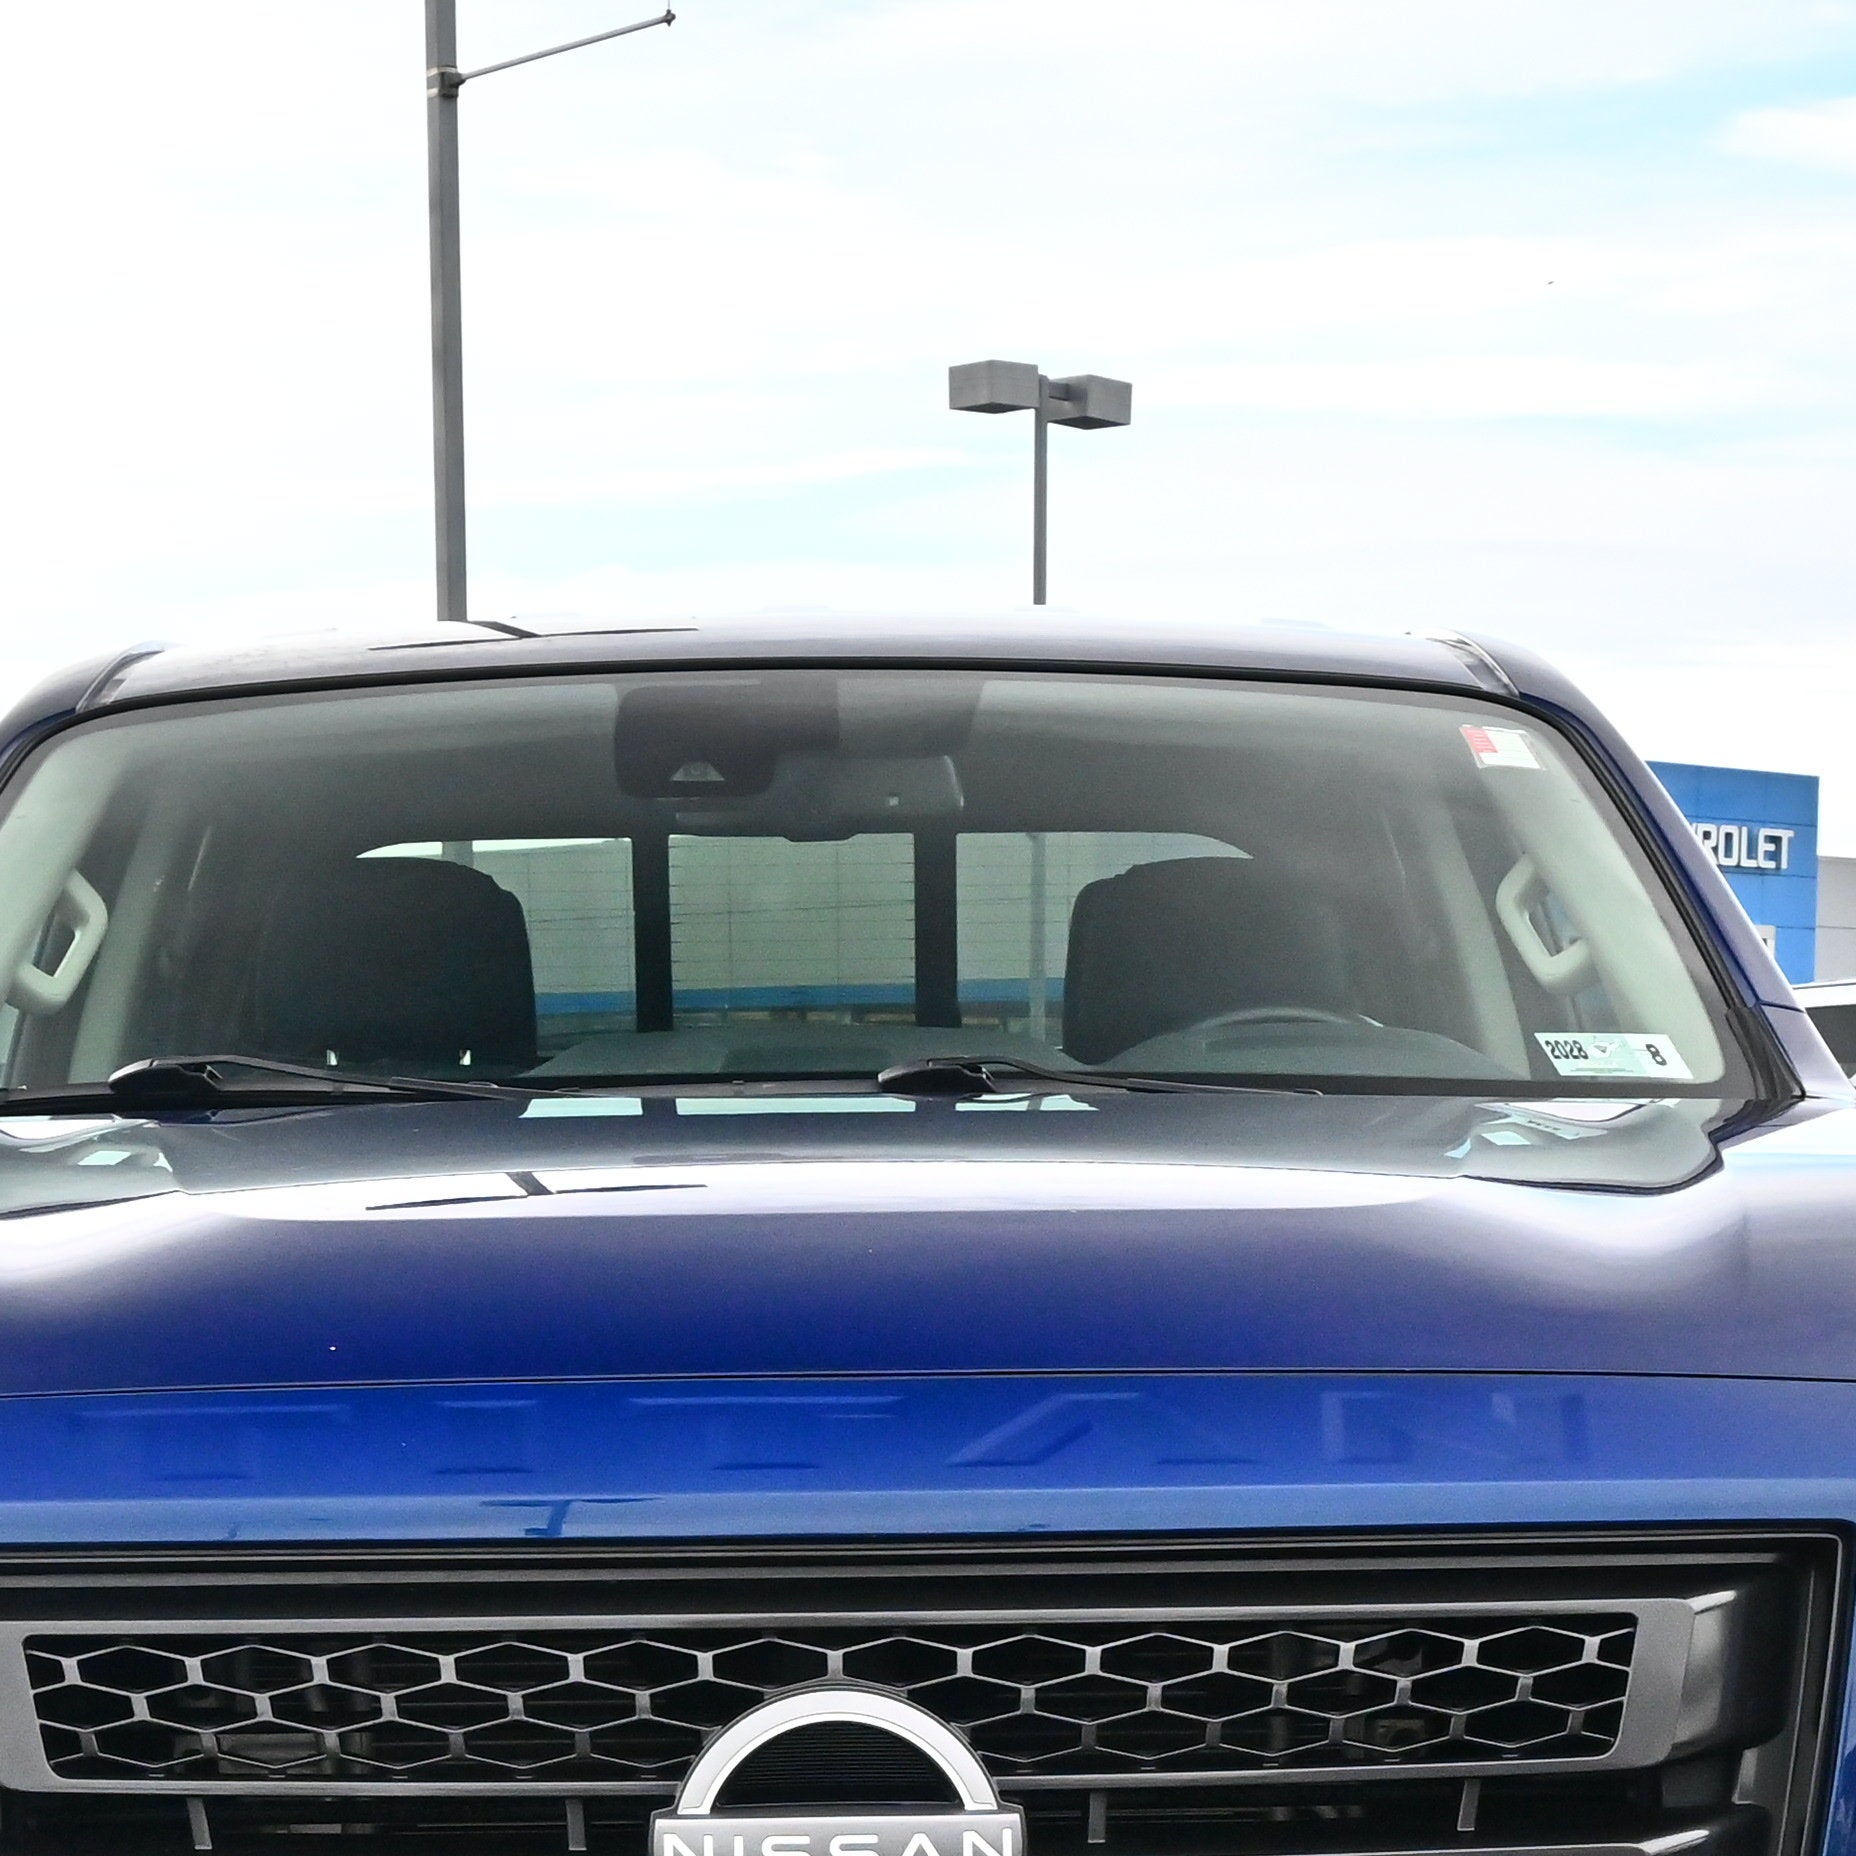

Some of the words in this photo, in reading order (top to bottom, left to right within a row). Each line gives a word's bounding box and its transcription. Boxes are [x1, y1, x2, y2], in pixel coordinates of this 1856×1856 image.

[1691, 822, 1795, 870] ROLET
[1545, 1040, 1589, 1060] 2028
[1645, 1043, 1668, 1066] 8
